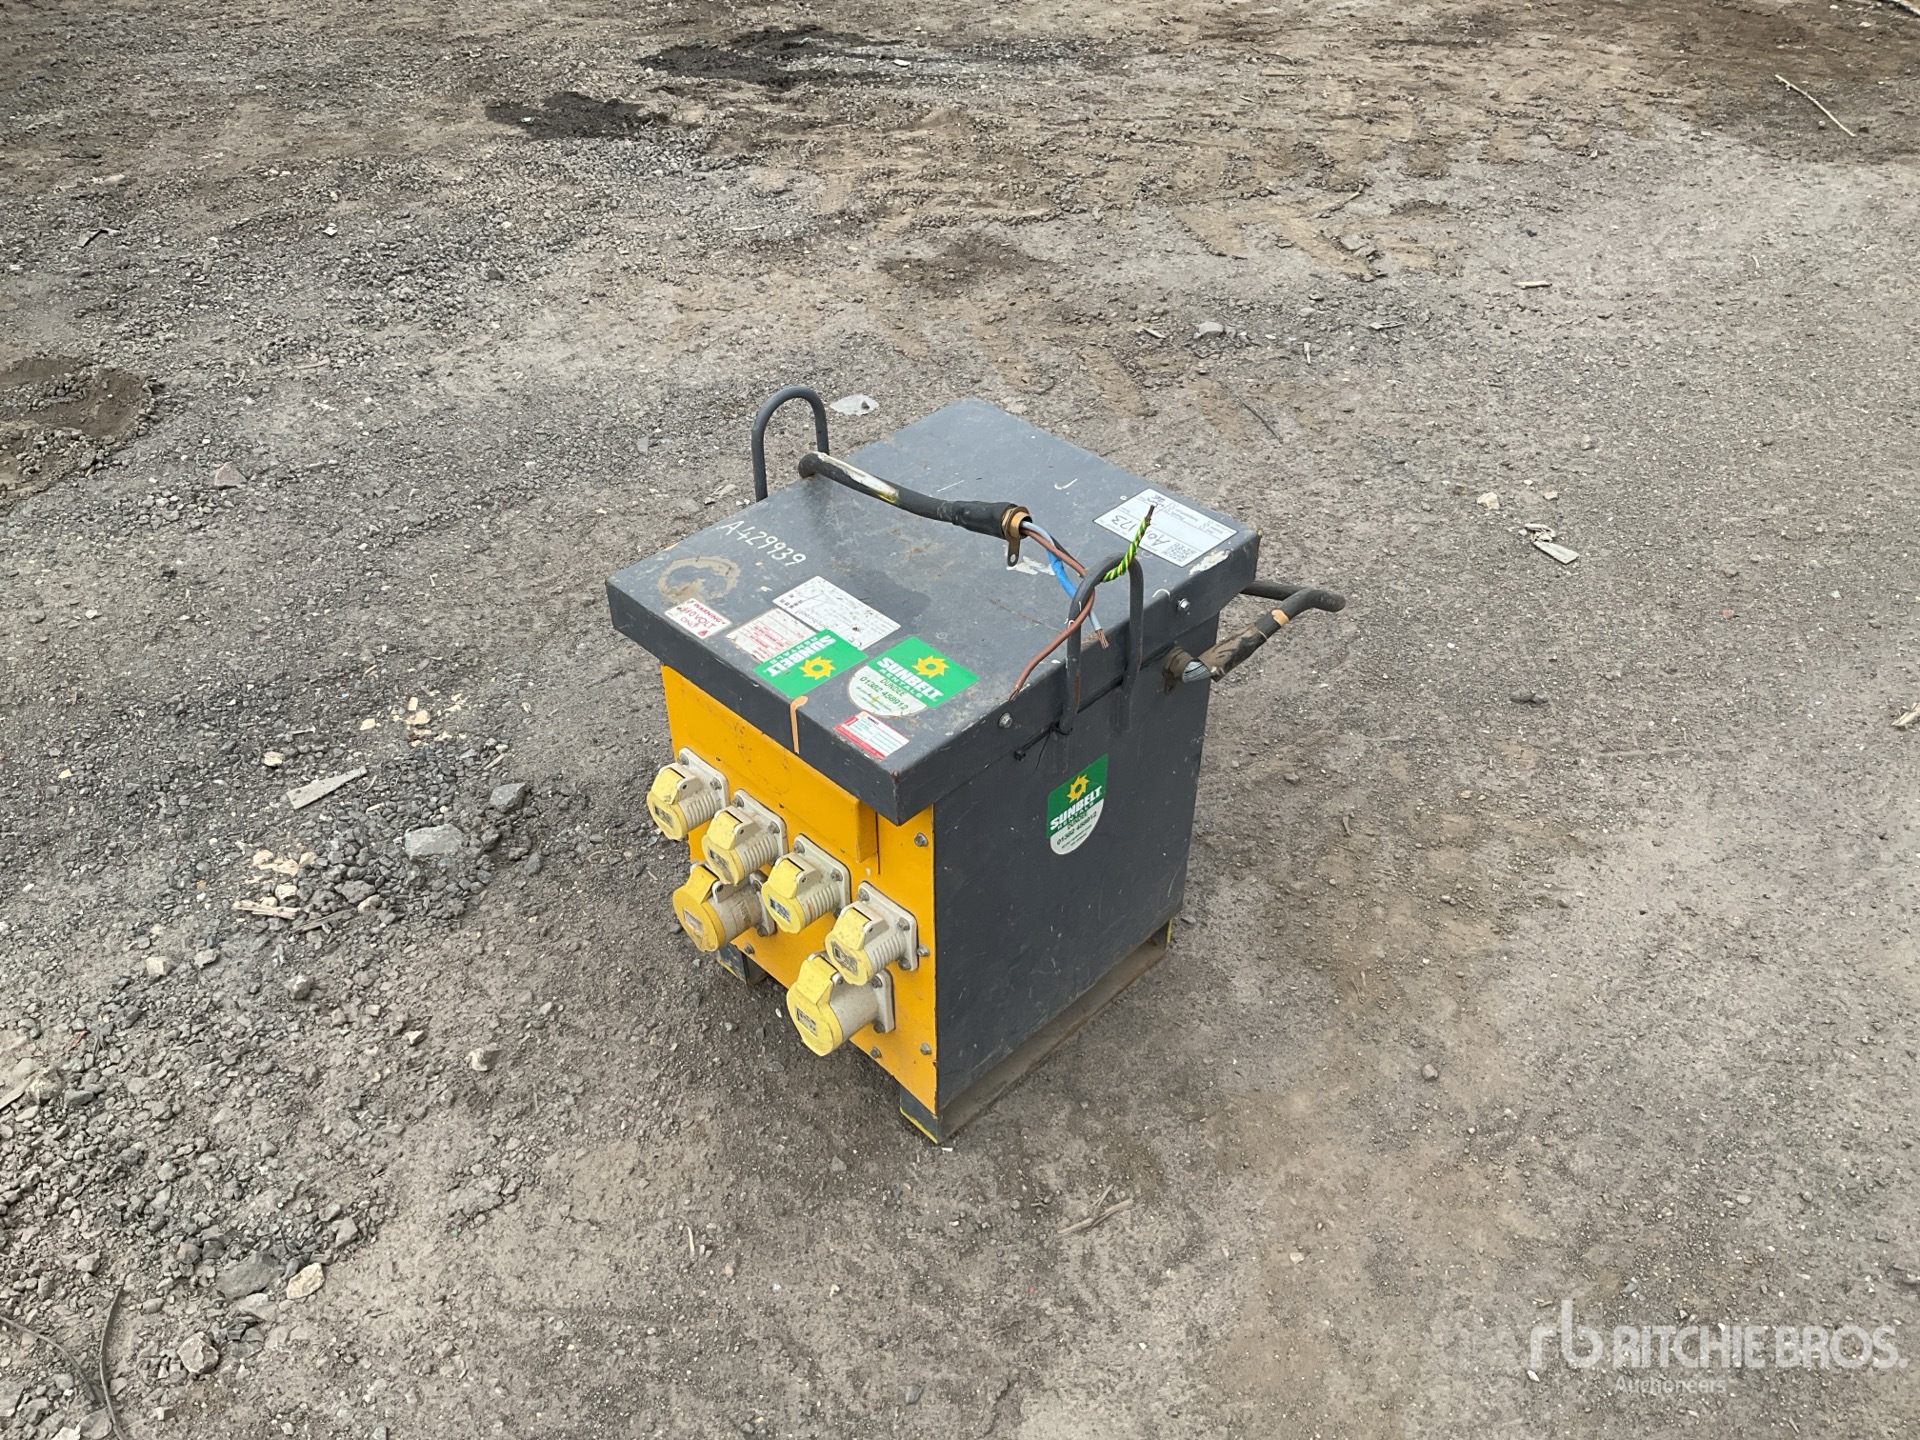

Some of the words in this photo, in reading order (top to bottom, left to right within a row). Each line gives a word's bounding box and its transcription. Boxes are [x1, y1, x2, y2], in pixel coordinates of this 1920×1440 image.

[718, 520, 806, 566] A429939
[695, 614, 716, 628] VOLT
[766, 634, 837, 678] SUNBELT
[769, 637, 819, 665] RENTALS
[859, 676, 883, 692] 01382
[881, 691, 909, 710] 458912
[877, 656, 944, 700] SUNBELT
[878, 669, 924, 699] RENTALS
[879, 678, 908, 697] DUNDEE
[1050, 785, 1102, 831] SUNBELT
